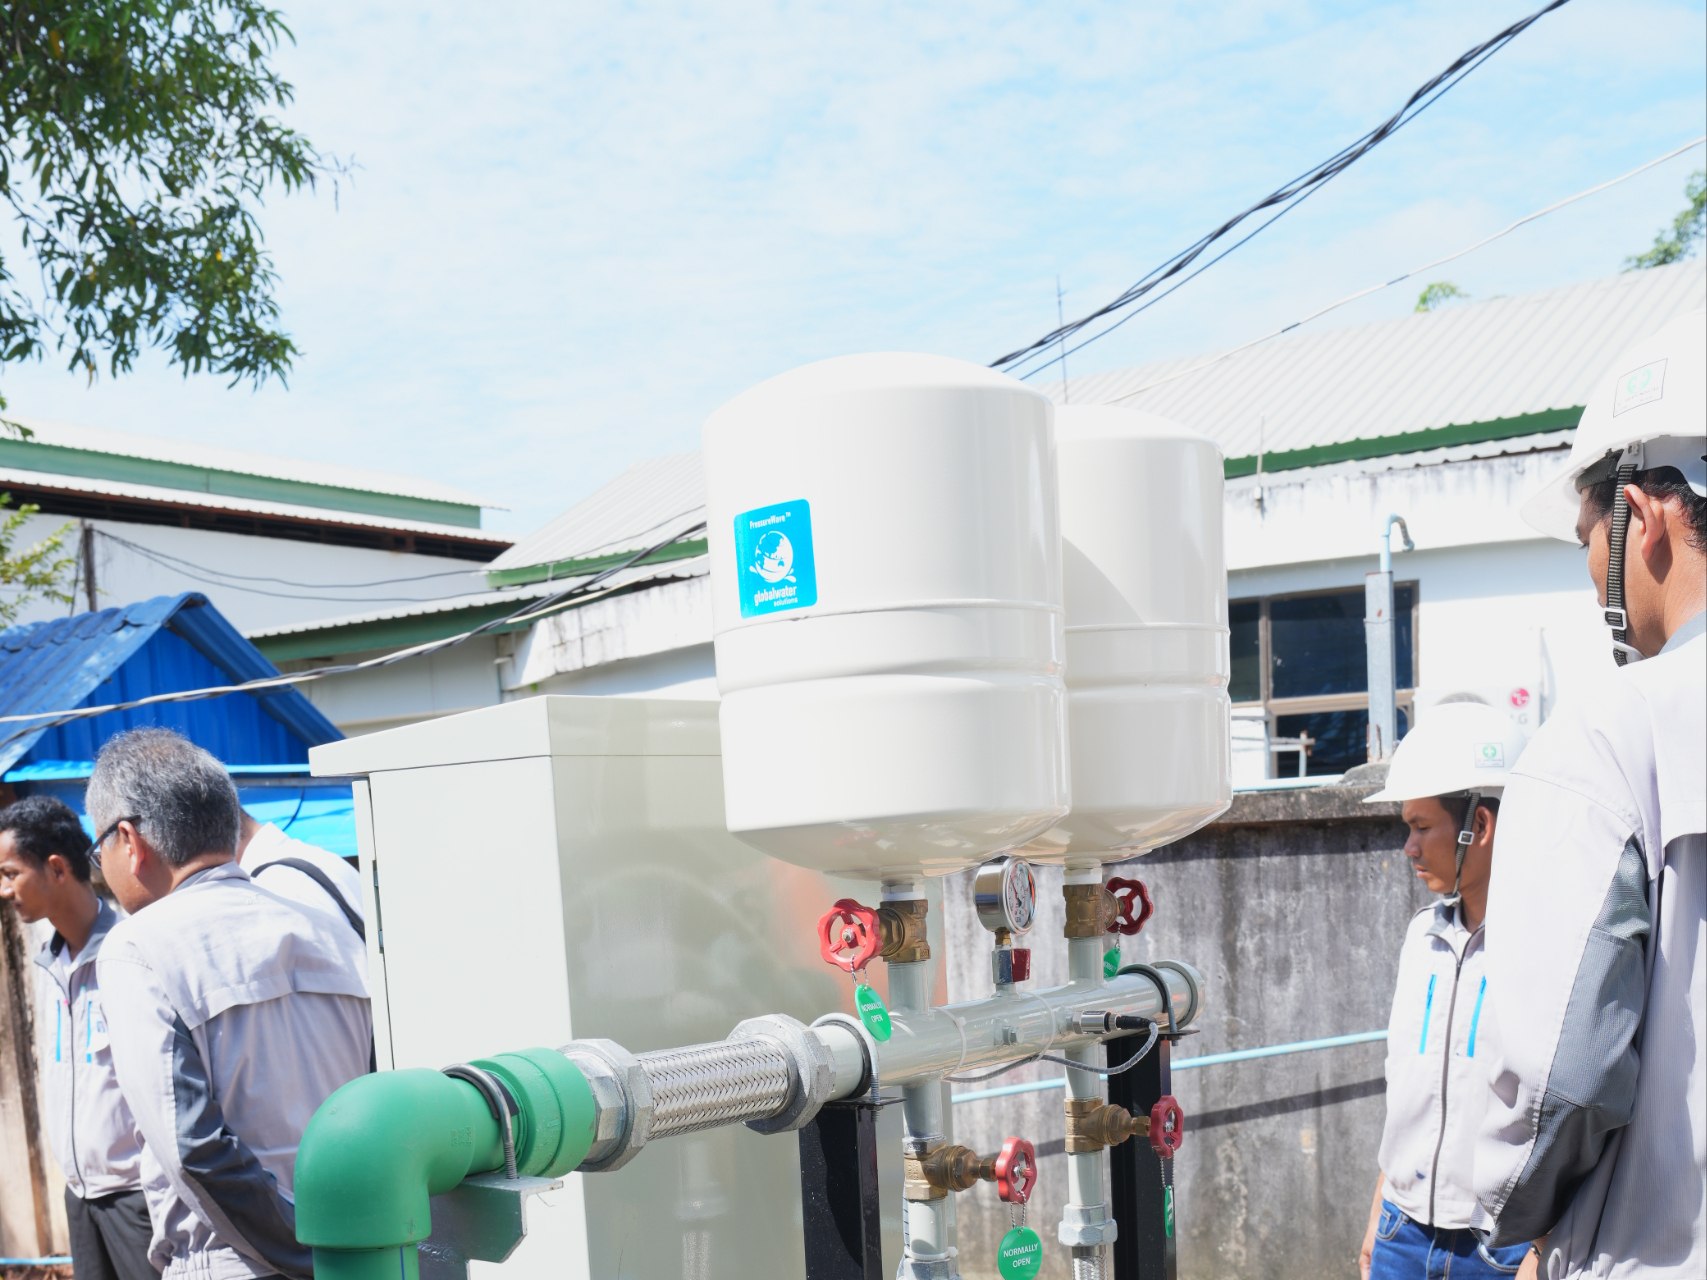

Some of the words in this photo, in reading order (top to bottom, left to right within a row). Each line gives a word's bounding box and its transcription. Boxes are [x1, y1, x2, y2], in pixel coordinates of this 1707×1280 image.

[754, 585, 797, 606] globalwater
[774, 597, 798, 607] solutions
[870, 1014, 883, 1023] OPEN
[1003, 1243, 1038, 1258] NORMALLY
[1012, 1257, 1031, 1268] OPEN
